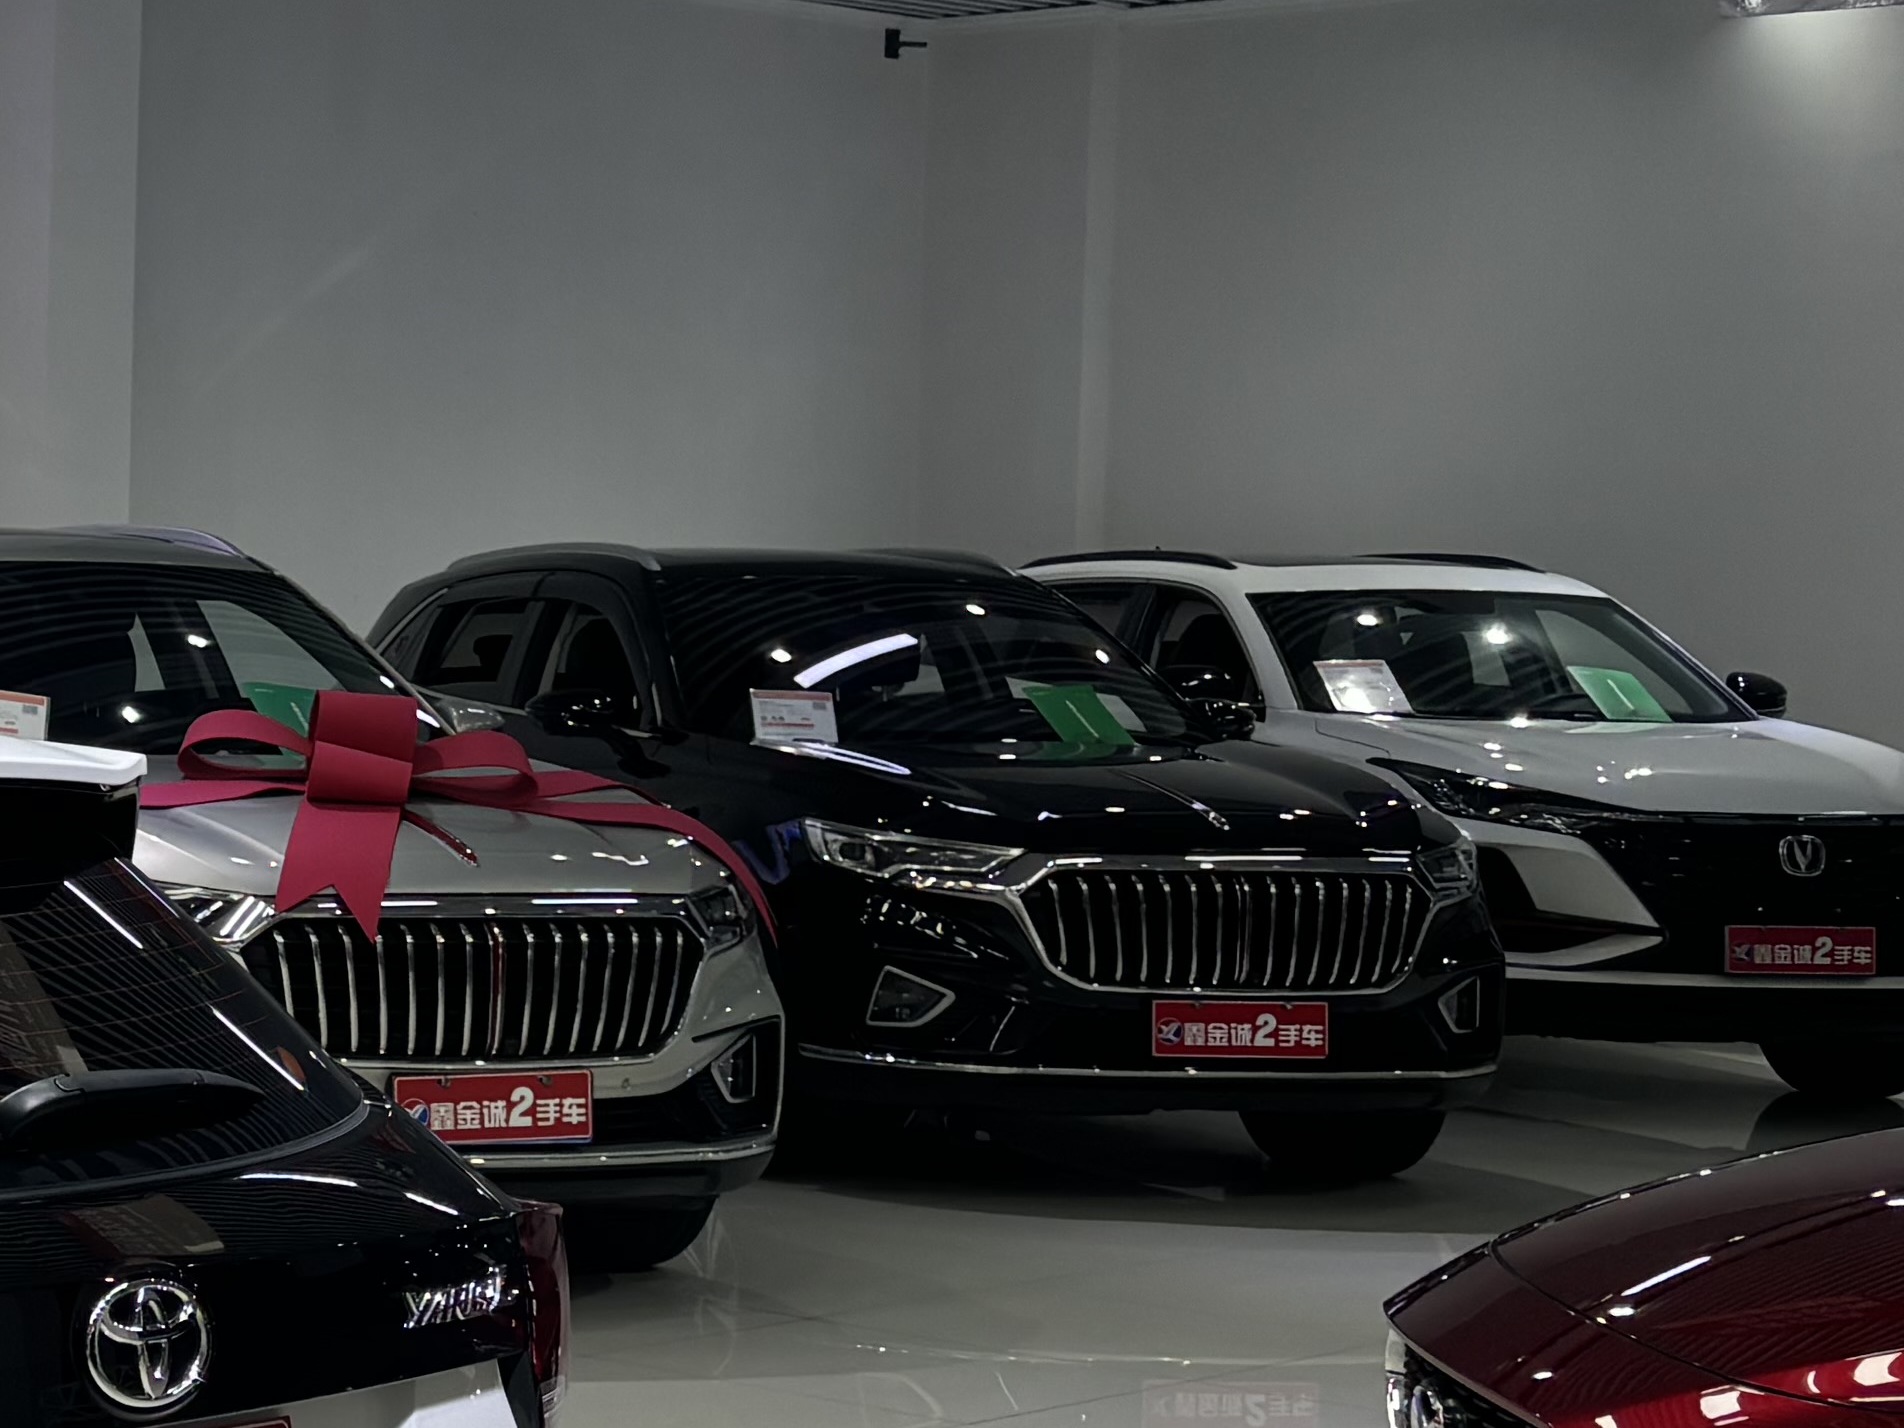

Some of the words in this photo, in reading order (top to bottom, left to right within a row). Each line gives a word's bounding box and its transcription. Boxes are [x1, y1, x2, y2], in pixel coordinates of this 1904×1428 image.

[1184, 1012, 1324, 1048] 鑫金诚2手车
[429, 1085, 588, 1132] 鑫金诚2手车
